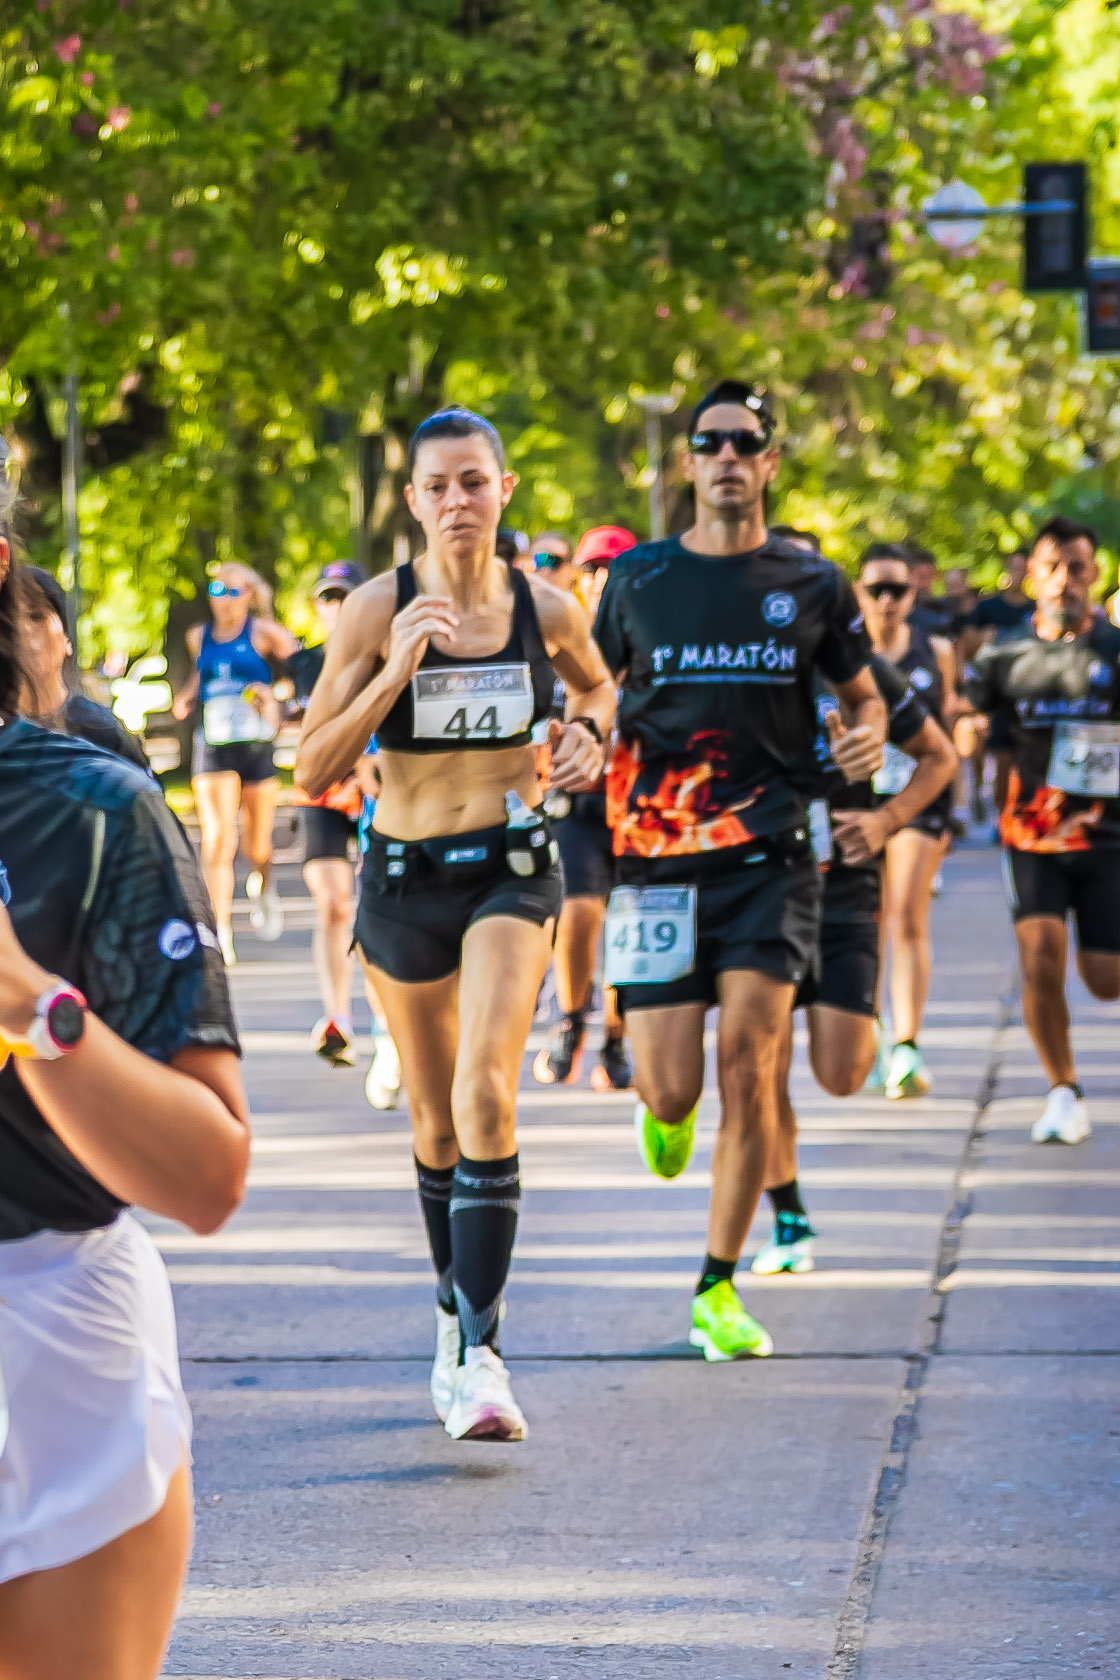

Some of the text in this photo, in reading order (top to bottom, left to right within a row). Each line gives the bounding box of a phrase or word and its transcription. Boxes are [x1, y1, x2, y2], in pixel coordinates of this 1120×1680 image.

[678, 636, 797, 671] MARATÓN
[442, 704, 503, 740] 44
[612, 920, 679, 953] 419
